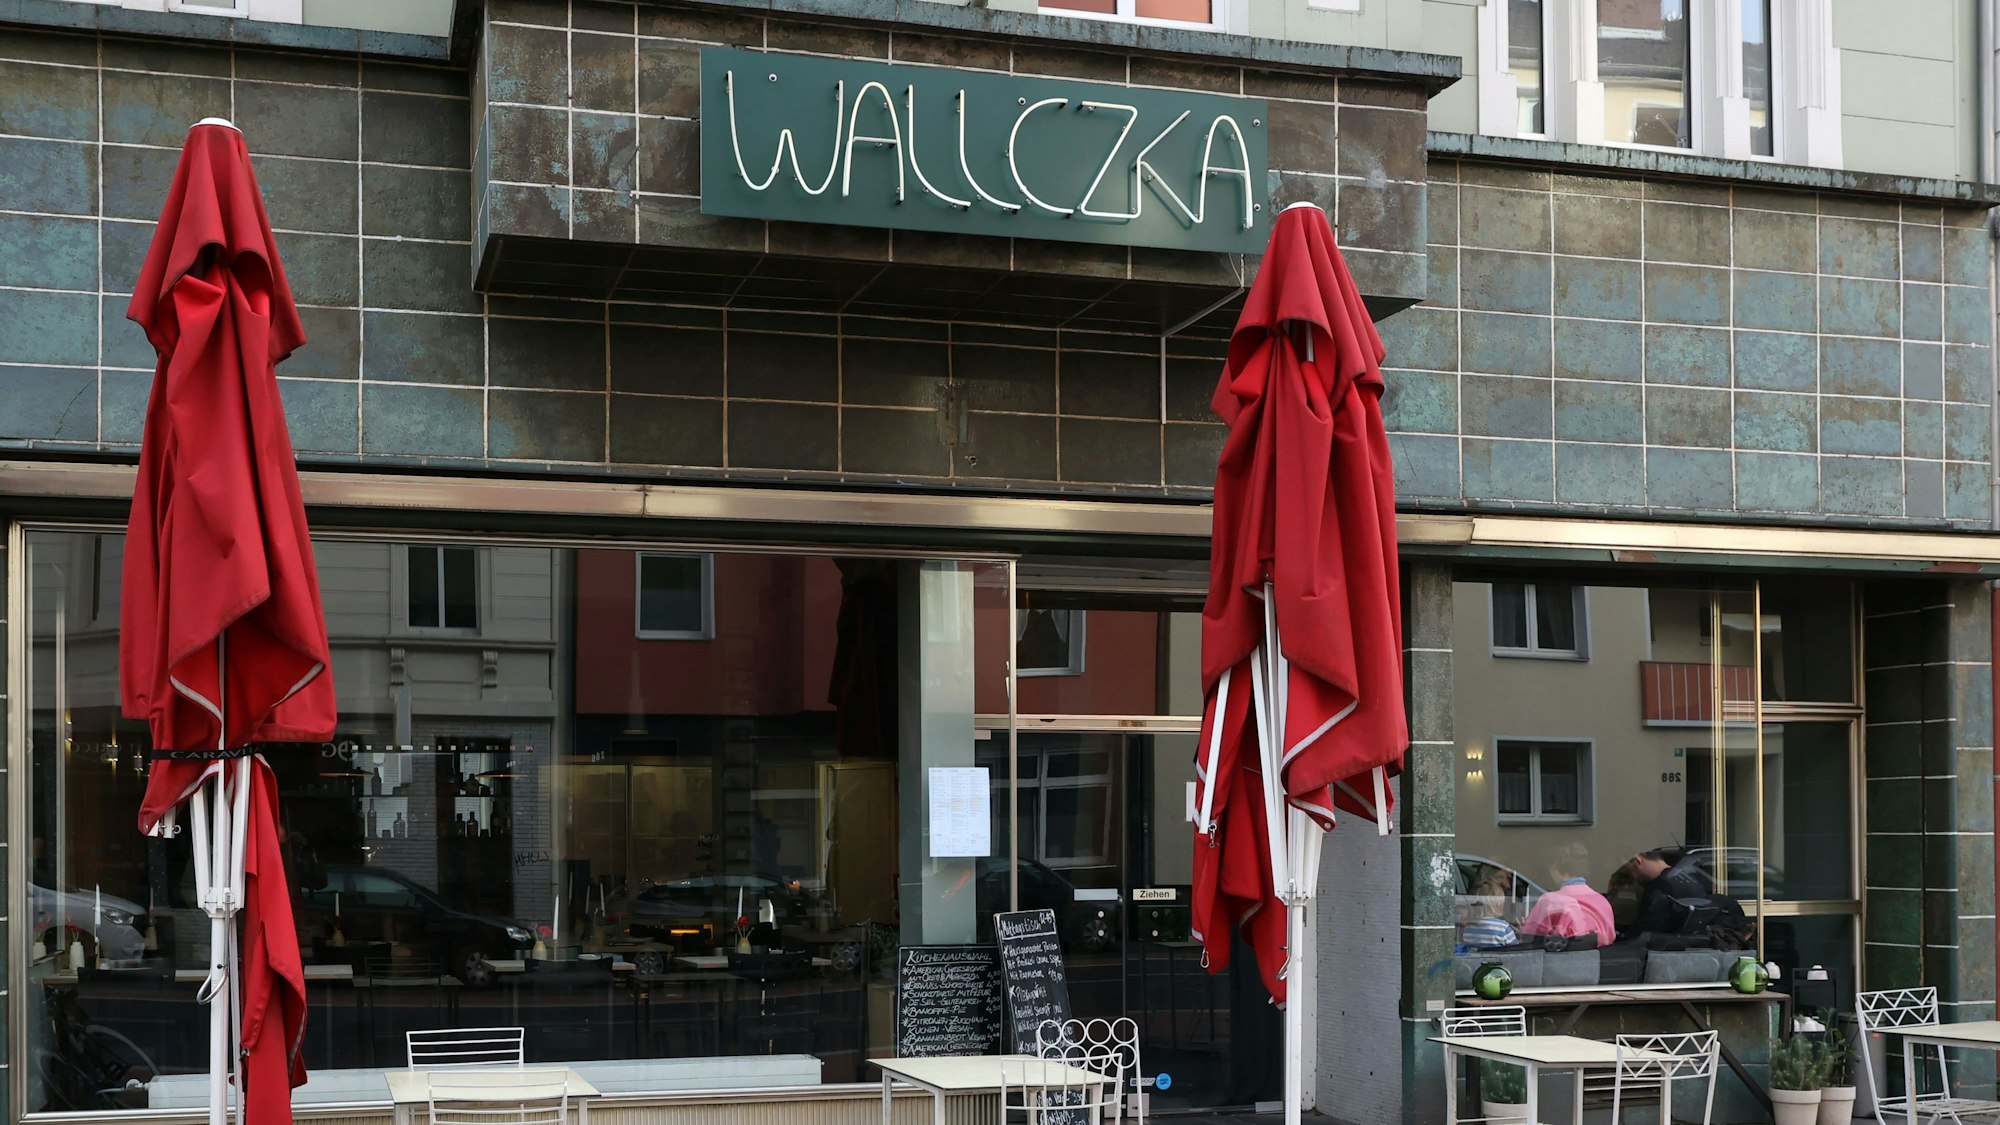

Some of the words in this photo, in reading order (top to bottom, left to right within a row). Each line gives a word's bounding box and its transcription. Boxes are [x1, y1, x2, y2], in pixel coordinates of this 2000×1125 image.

[727, 71, 1254, 229] WALLCZKA
[1139, 890, 1170, 898] Ziehen
[906, 950, 992, 965] KUCHENAUSWAHL
